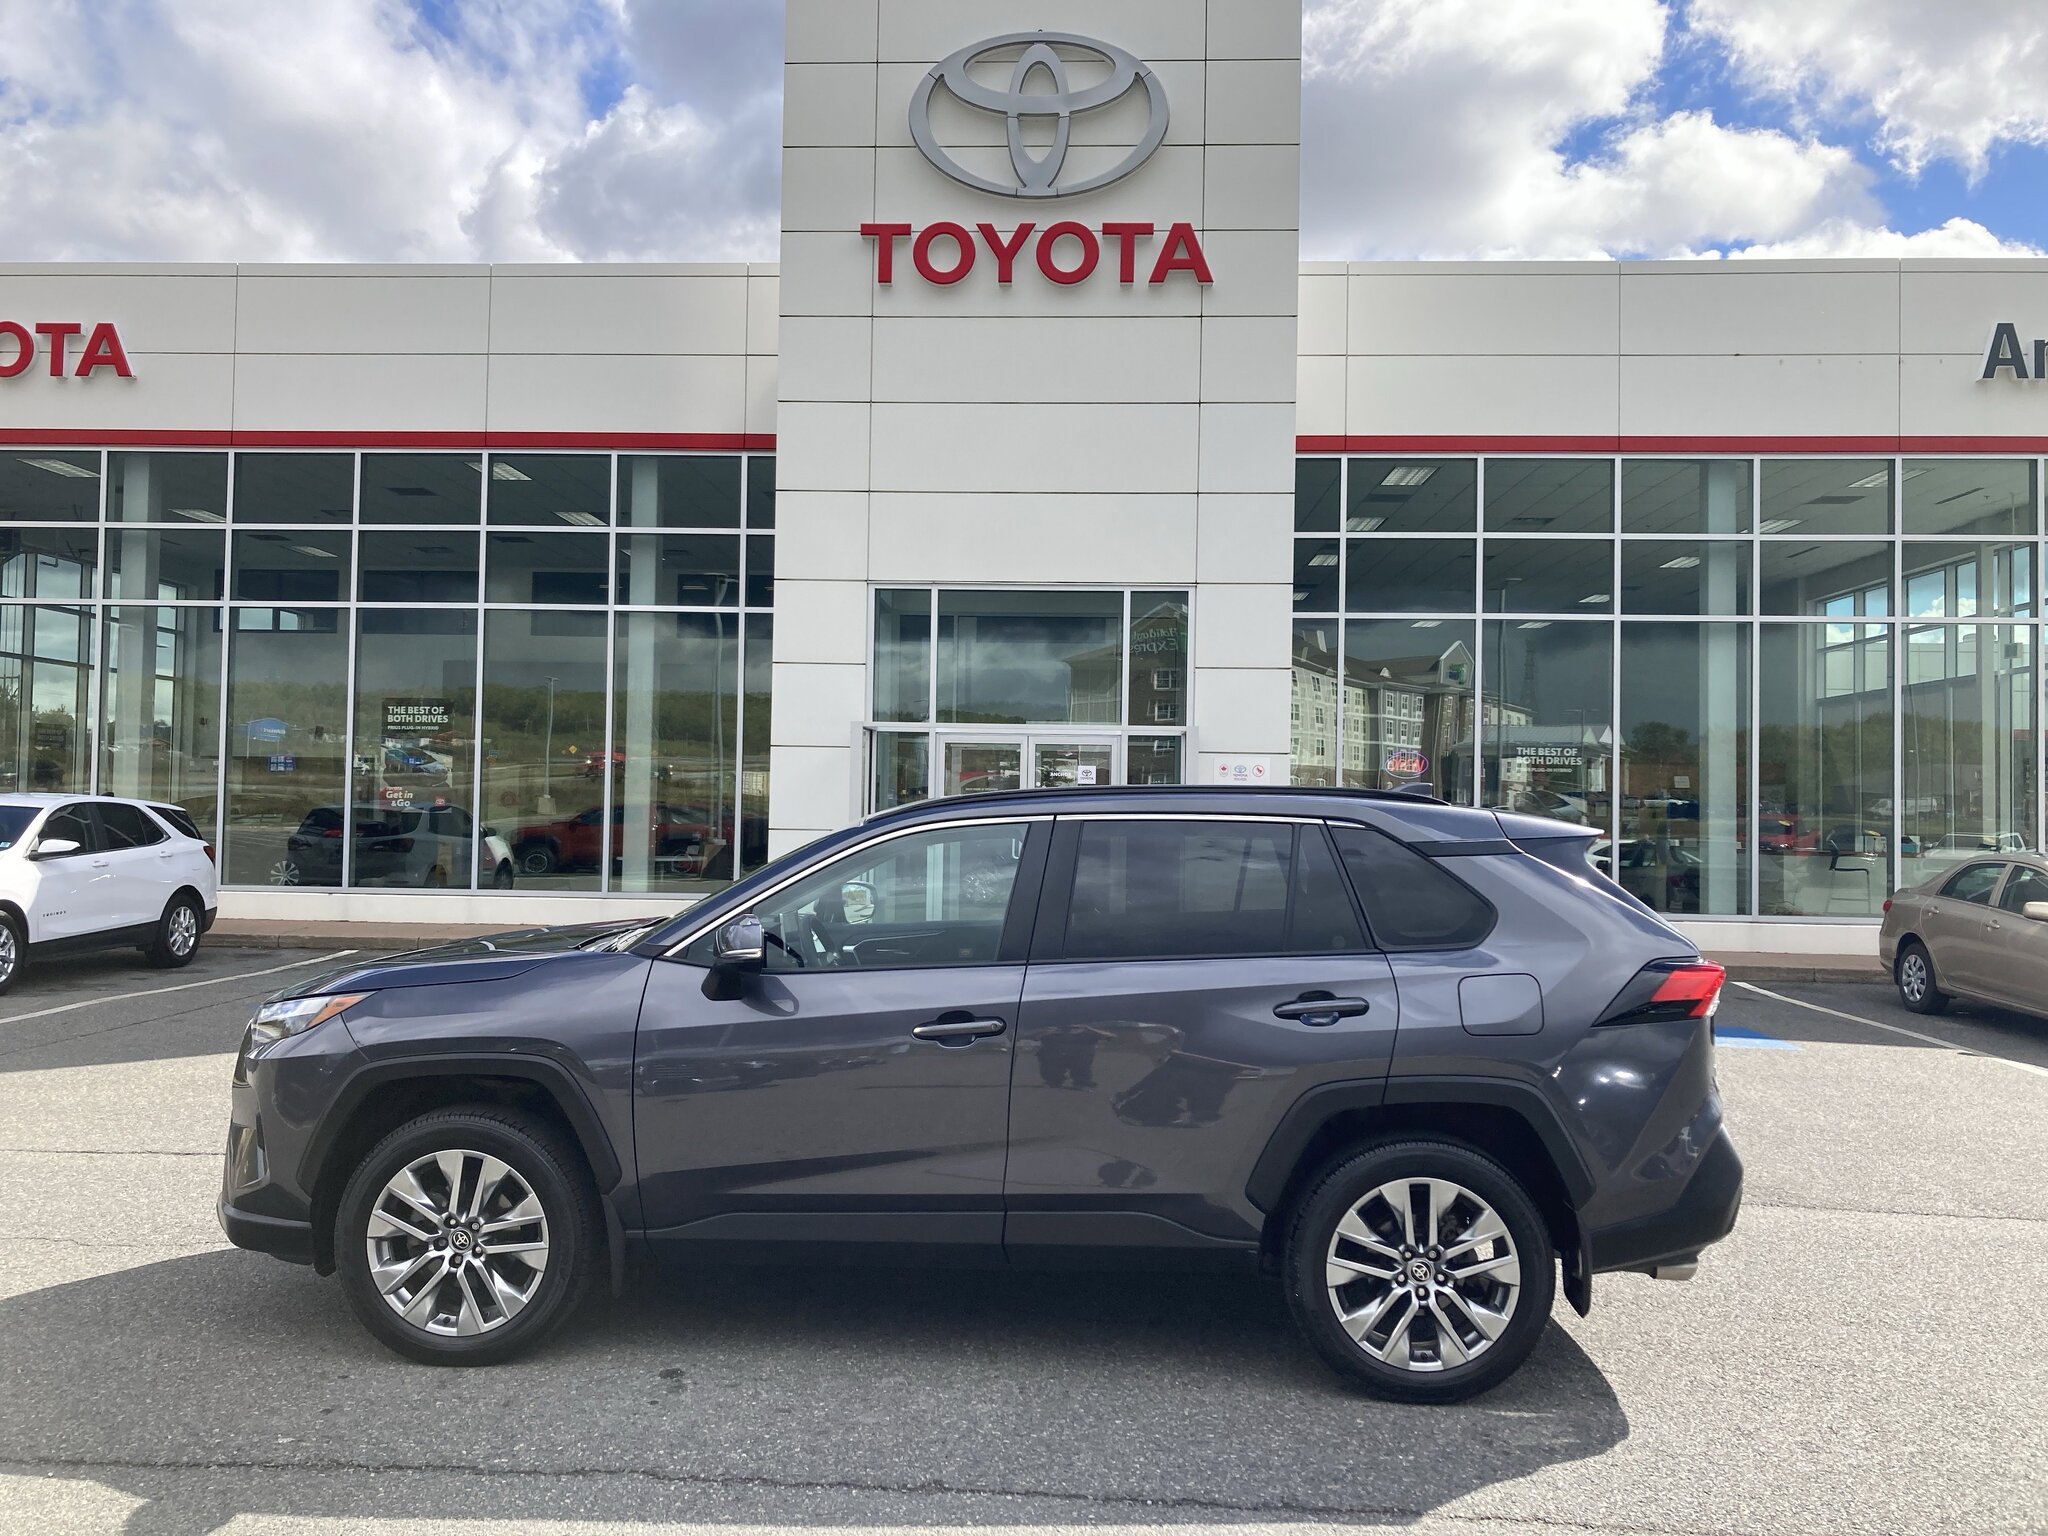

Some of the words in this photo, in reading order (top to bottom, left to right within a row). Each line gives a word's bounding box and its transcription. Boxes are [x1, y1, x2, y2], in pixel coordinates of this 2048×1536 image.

[860, 221, 1214, 286] TOYOTA
[0, 320, 133, 378] OTA
[387, 706, 406, 714] THE
[407, 706, 430, 714] BEST
[431, 706, 445, 714] OF
[387, 715, 413, 723] BOTH
[414, 715, 449, 723] DRIVES
[1516, 747, 1537, 756] THE
[1538, 747, 1563, 756] BEST
[1563, 748, 1578, 756] OF
[1516, 756, 1545, 765] BOTH
[1546, 757, 1583, 766] DRIVES
[385, 791, 403, 799] Get
[404, 790, 414, 799] in
